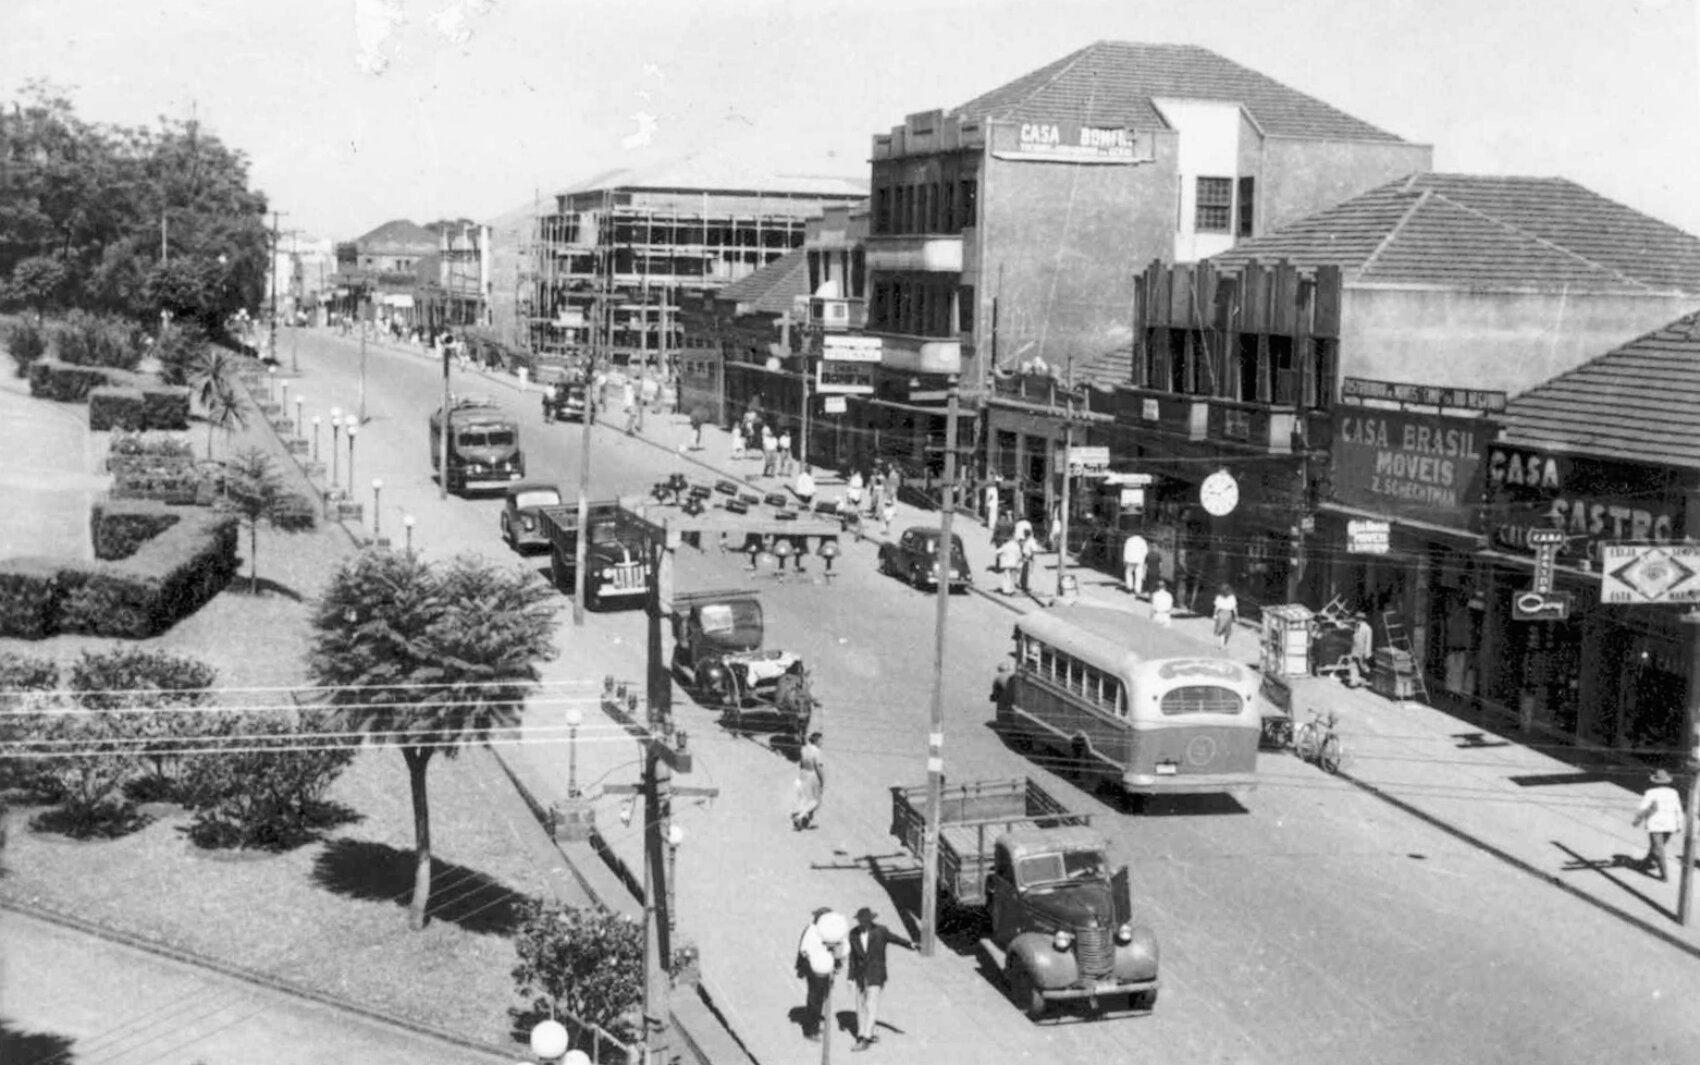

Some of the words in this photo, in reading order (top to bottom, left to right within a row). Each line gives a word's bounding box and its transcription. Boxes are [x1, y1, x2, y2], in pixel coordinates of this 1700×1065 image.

[1021, 123, 1060, 144] CASA
[1342, 418, 1388, 448] CASA
[1403, 424, 1480, 460] BRASIL
[1376, 451, 1454, 486] MOVEIS
[1490, 451, 1559, 487] CASA
